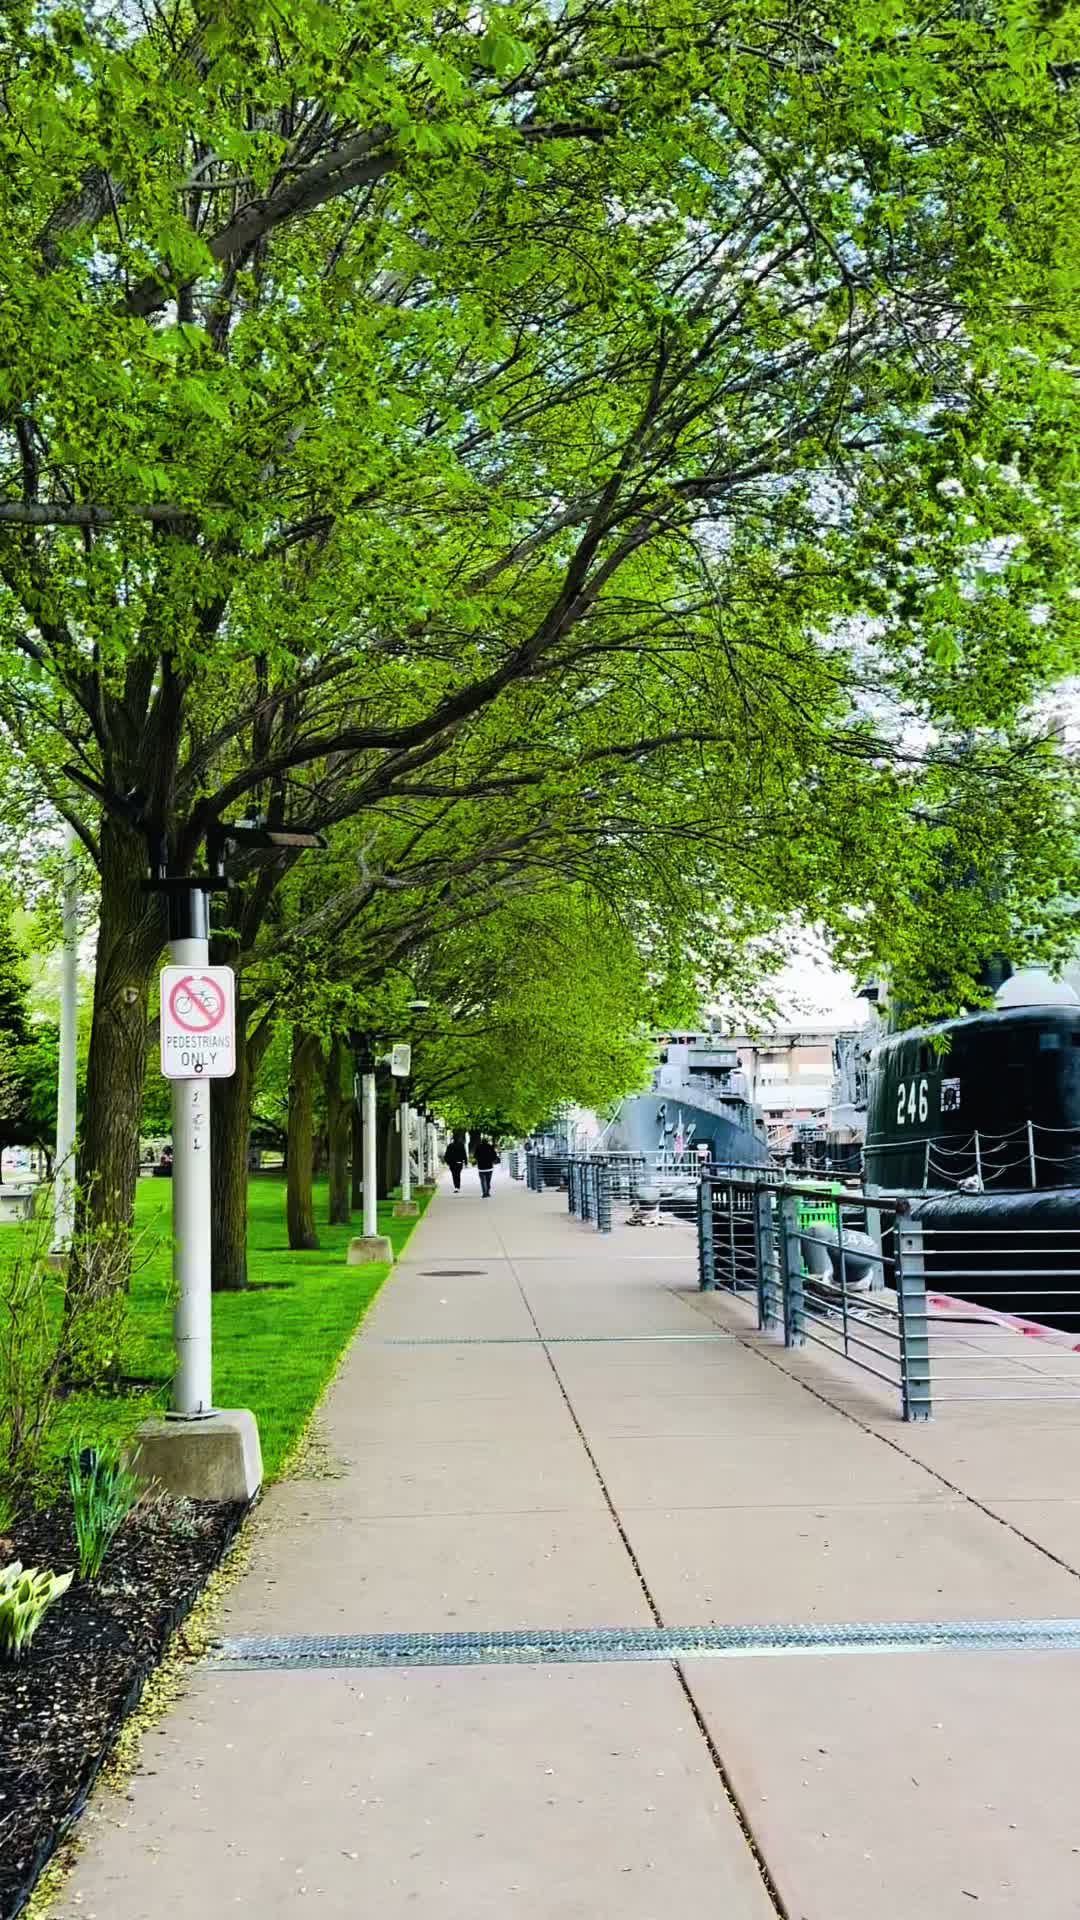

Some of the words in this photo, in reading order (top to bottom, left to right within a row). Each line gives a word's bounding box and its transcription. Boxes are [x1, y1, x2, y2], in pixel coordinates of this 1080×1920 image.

[167, 1035, 231, 1049] PEDESTRIANS
[181, 1051, 218, 1066] ONLY
[896, 1079, 929, 1125] 246
